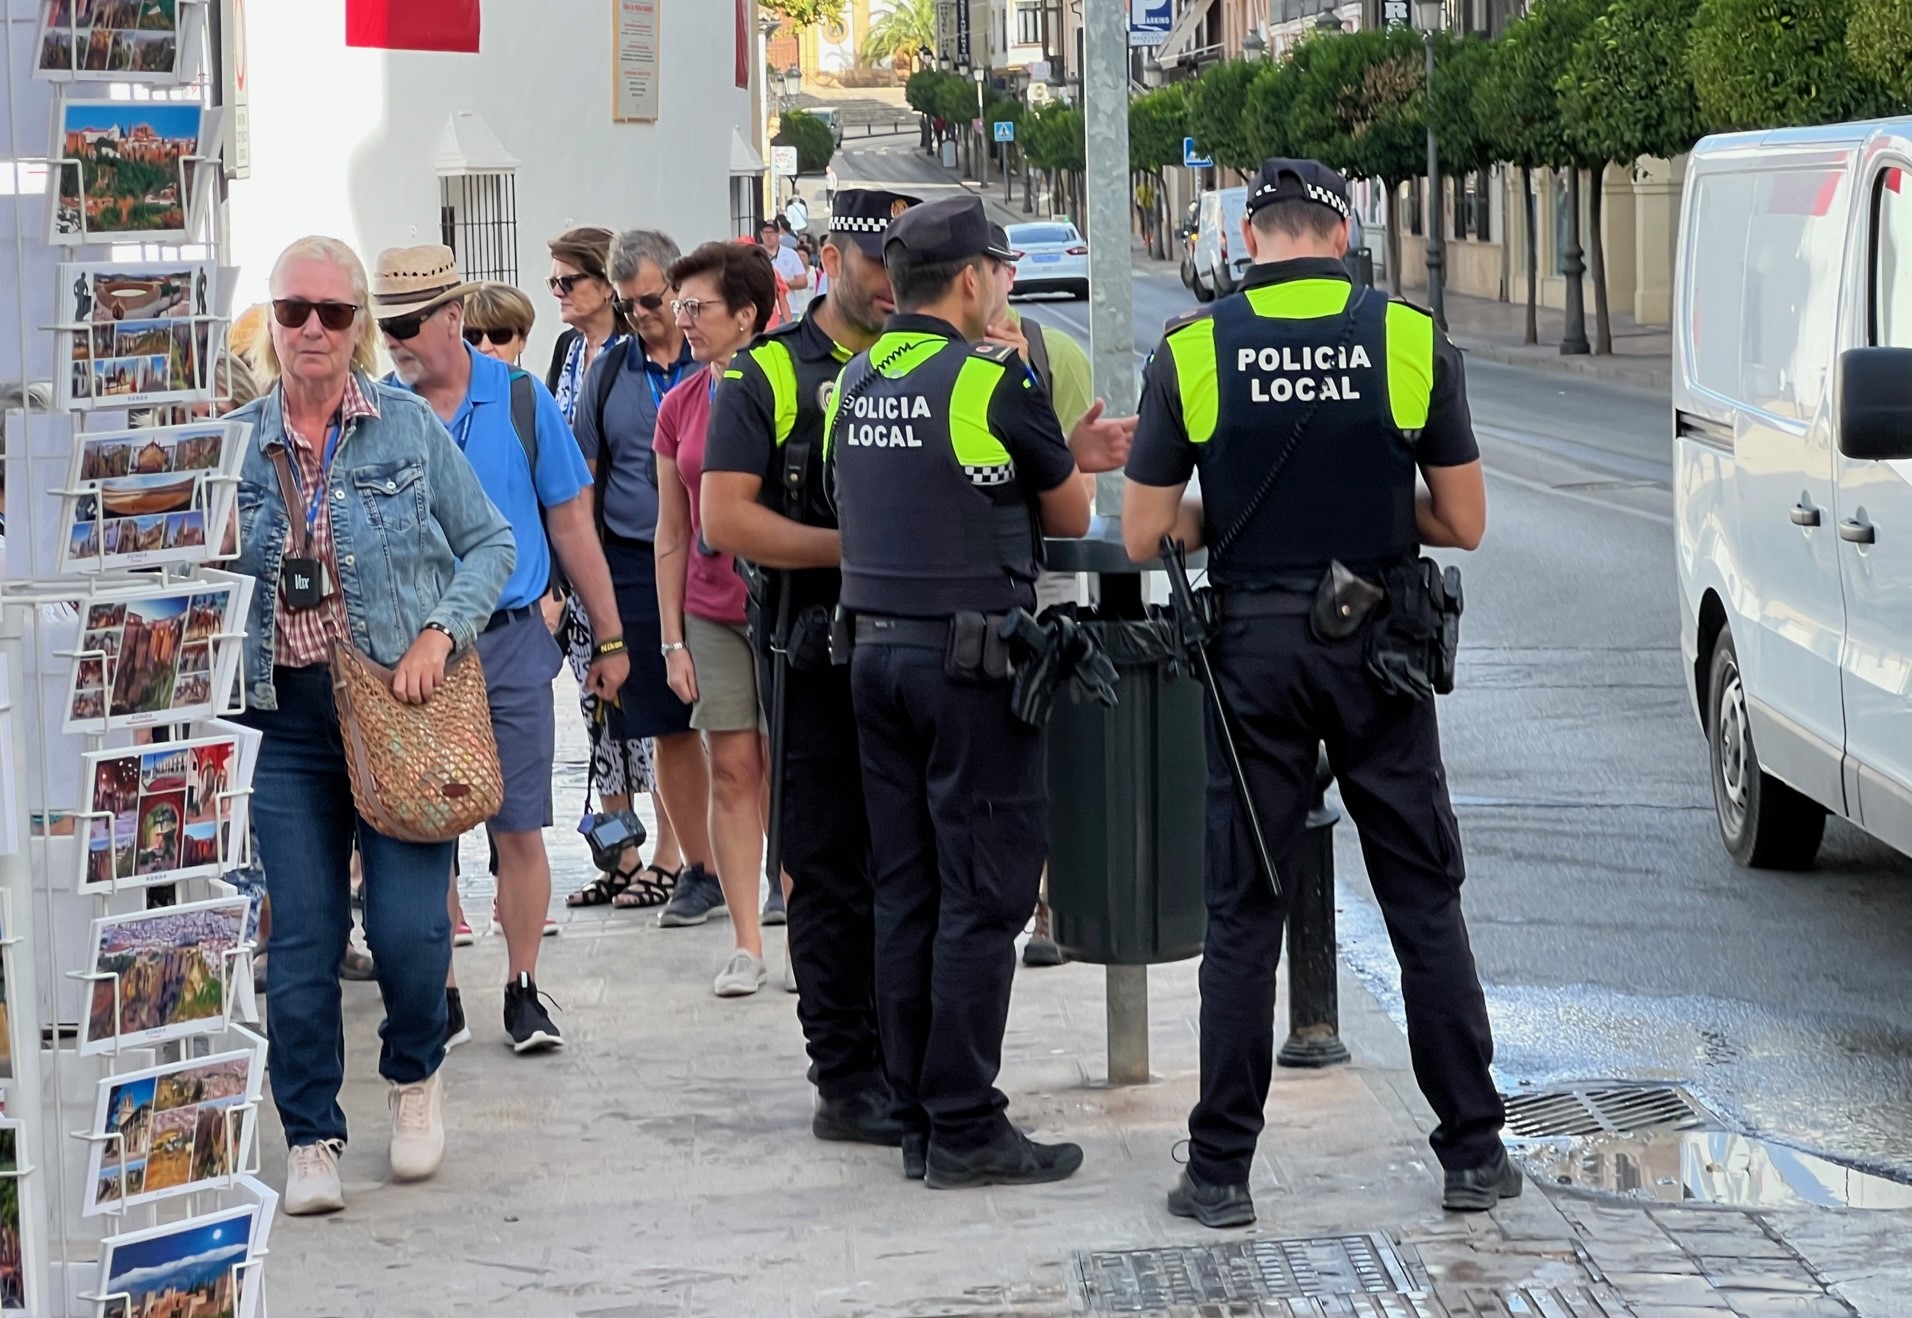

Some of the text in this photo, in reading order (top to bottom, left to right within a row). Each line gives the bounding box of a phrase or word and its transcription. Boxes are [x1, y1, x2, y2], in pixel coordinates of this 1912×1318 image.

[1237, 345, 1372, 371] POLICIA
[1251, 376, 1361, 402] LOCAL
[847, 423, 923, 448] LOCAL
[600, 640, 623, 654] Nikon
